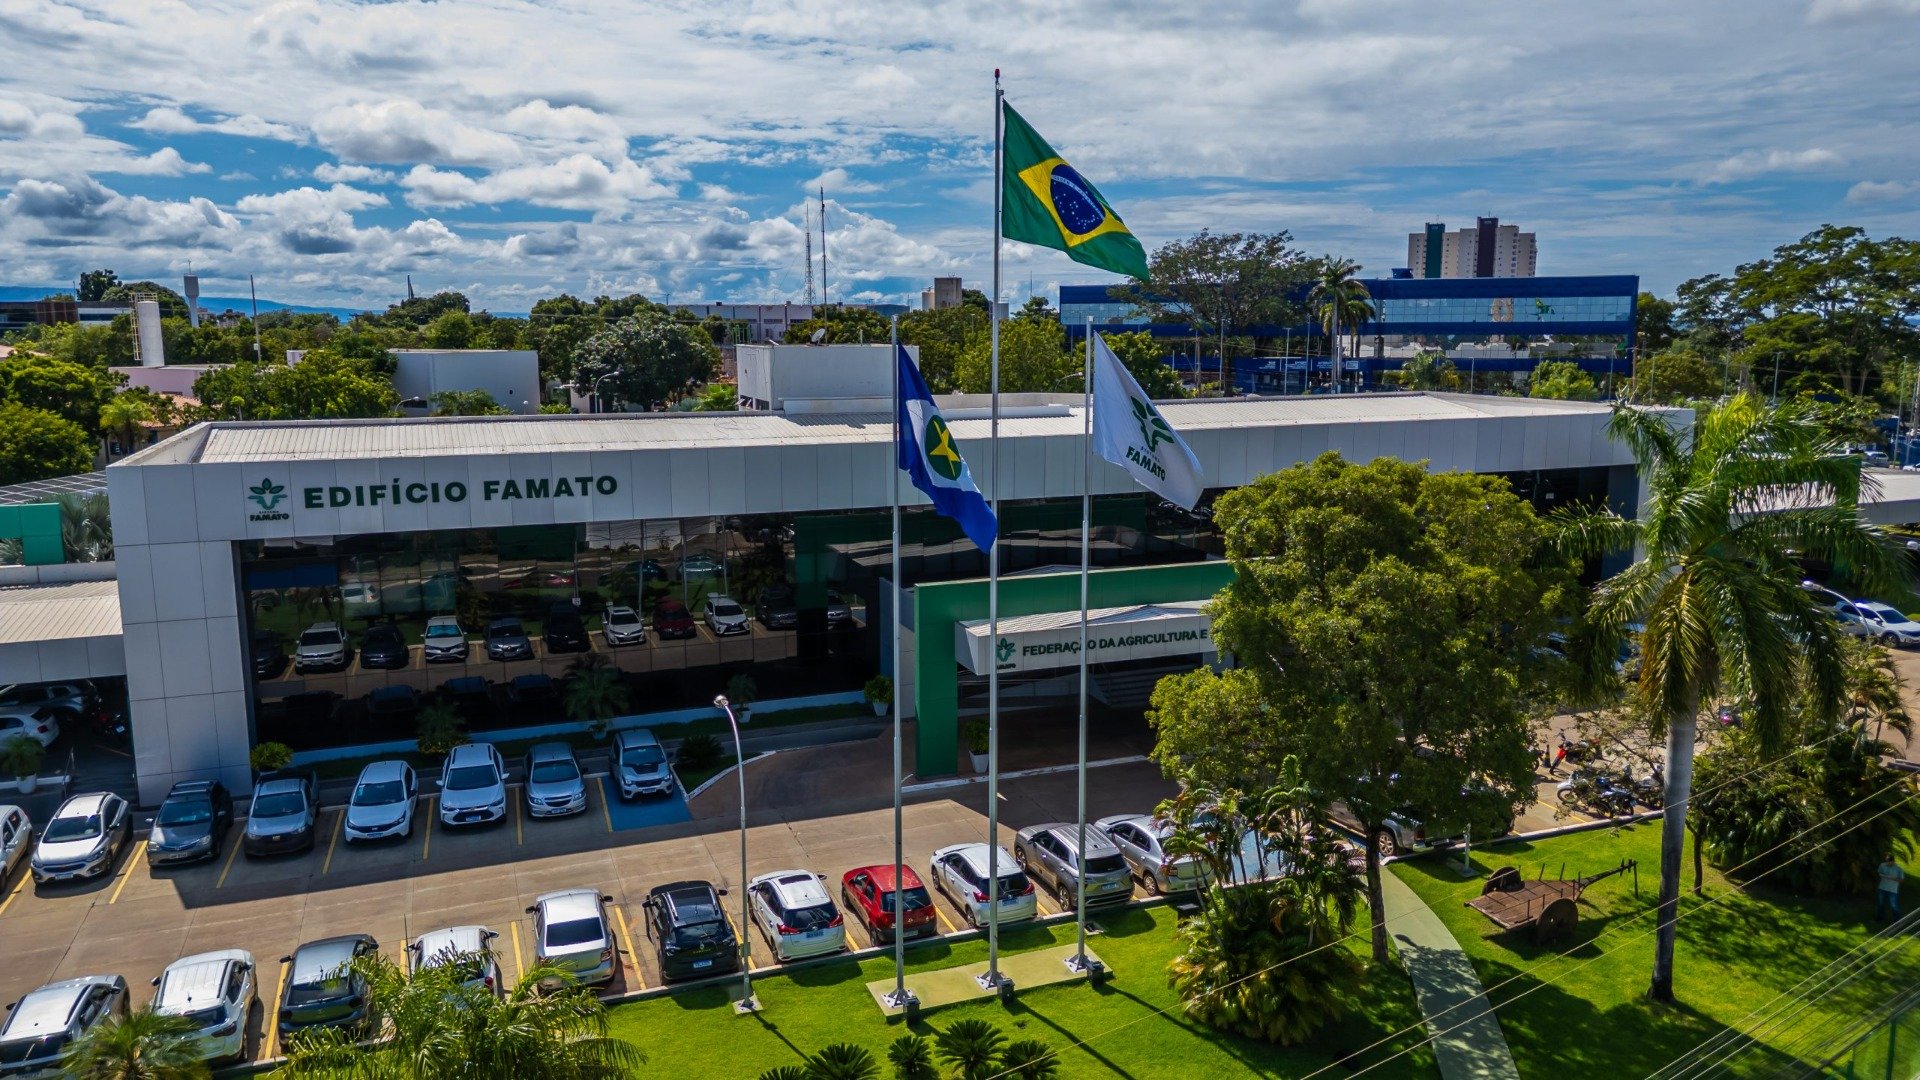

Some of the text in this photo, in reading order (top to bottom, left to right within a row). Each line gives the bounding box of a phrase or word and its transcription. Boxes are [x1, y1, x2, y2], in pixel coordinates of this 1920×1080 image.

[1125, 445, 1166, 481] FAMATO
[304, 475, 618, 509] EDIFÍCIO FAMATO
[249, 513, 290, 522] FAMATO
[1099, 637, 1116, 649] DA
[1117, 630, 1199, 647] AGRICULTURA
[1200, 629, 1208, 639] E
